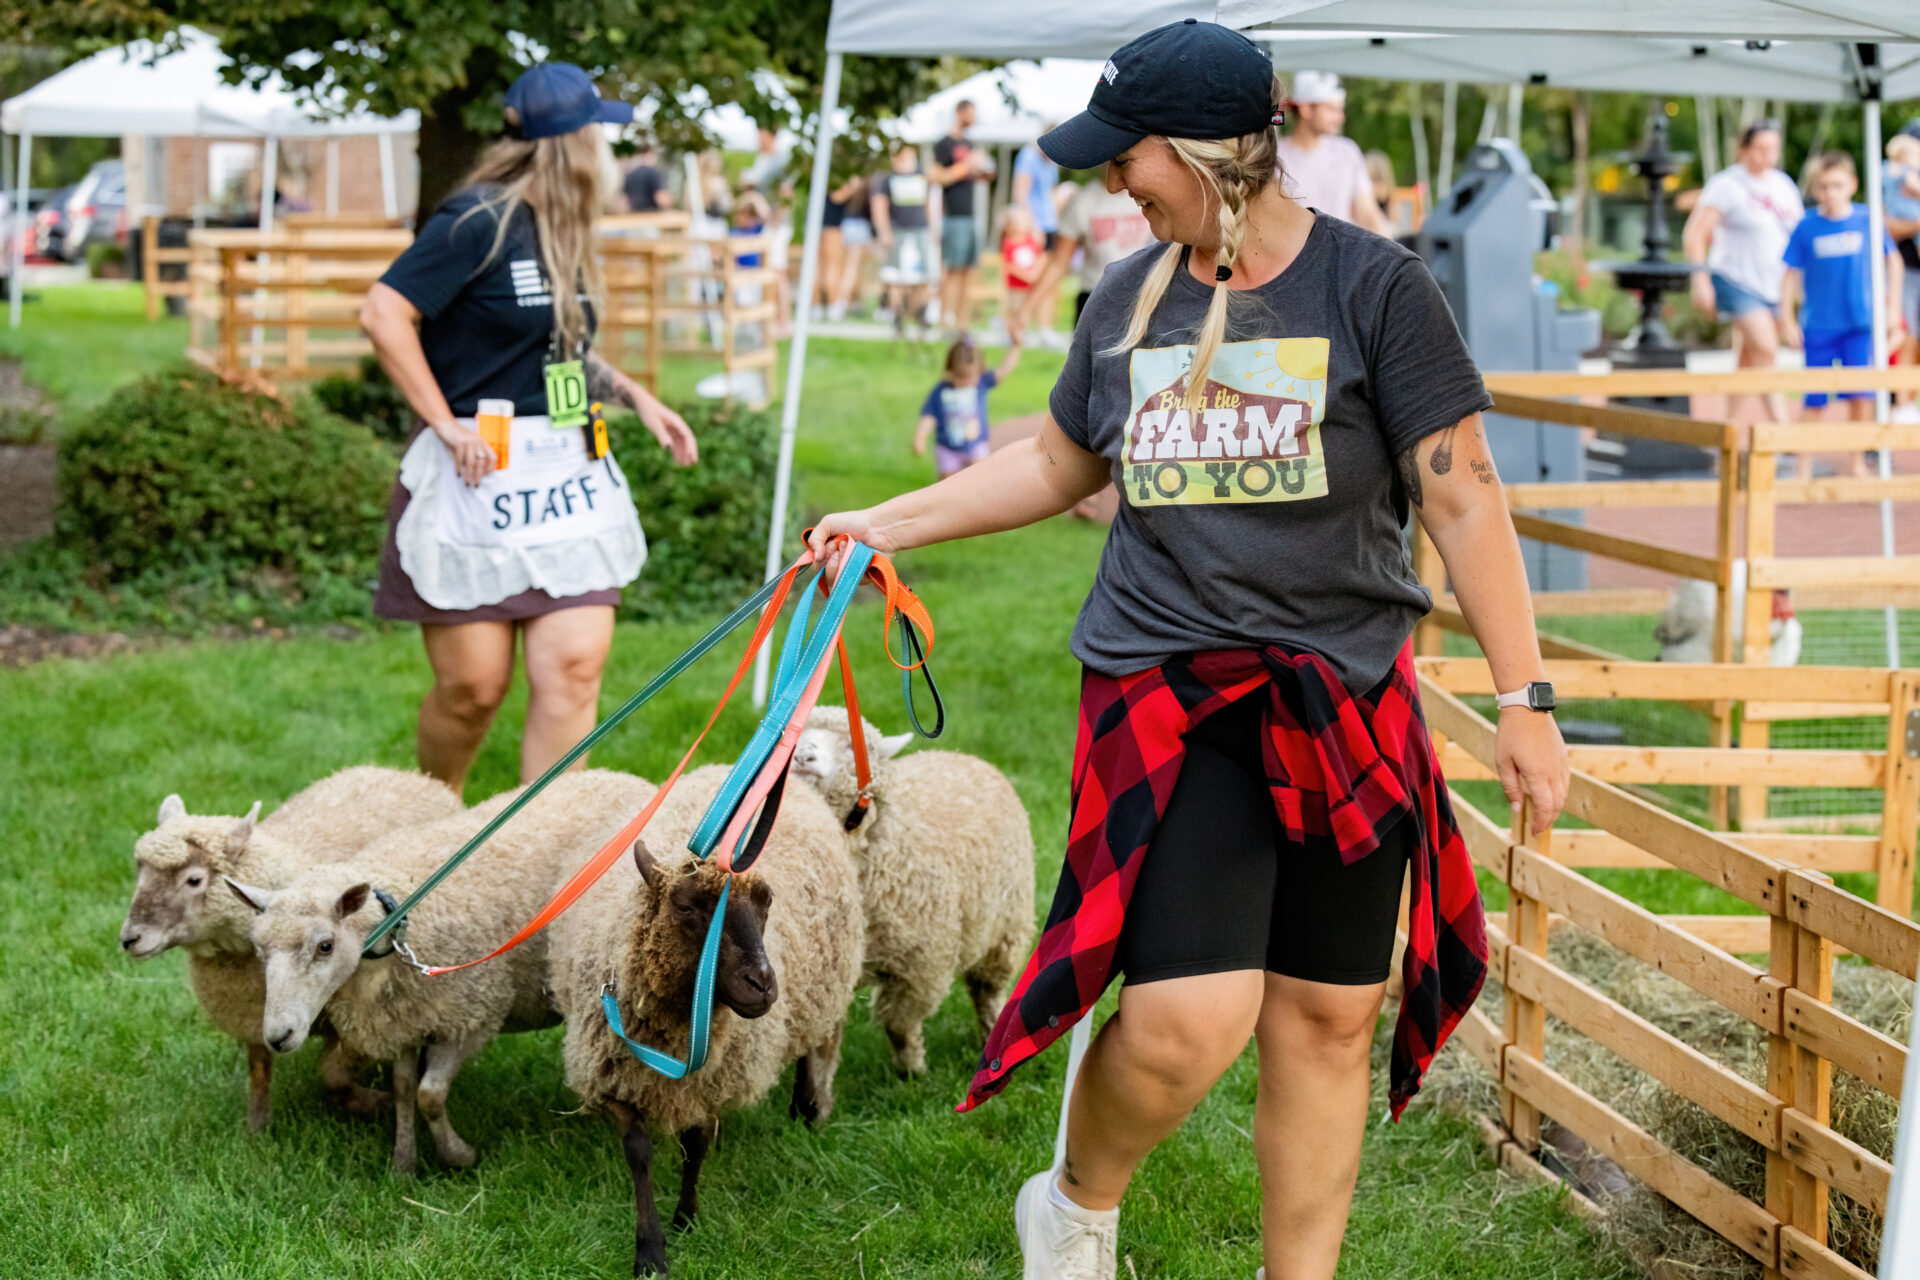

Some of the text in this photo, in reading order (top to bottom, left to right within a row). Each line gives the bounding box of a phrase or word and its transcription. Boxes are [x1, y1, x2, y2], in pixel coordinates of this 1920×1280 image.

[553, 376, 581, 411] ID
[1158, 388, 1241, 414] Brig the
[1133, 404, 1303, 460] FARM
[1132, 458, 1308, 501] TO YOU
[492, 475, 597, 530] STAFF
